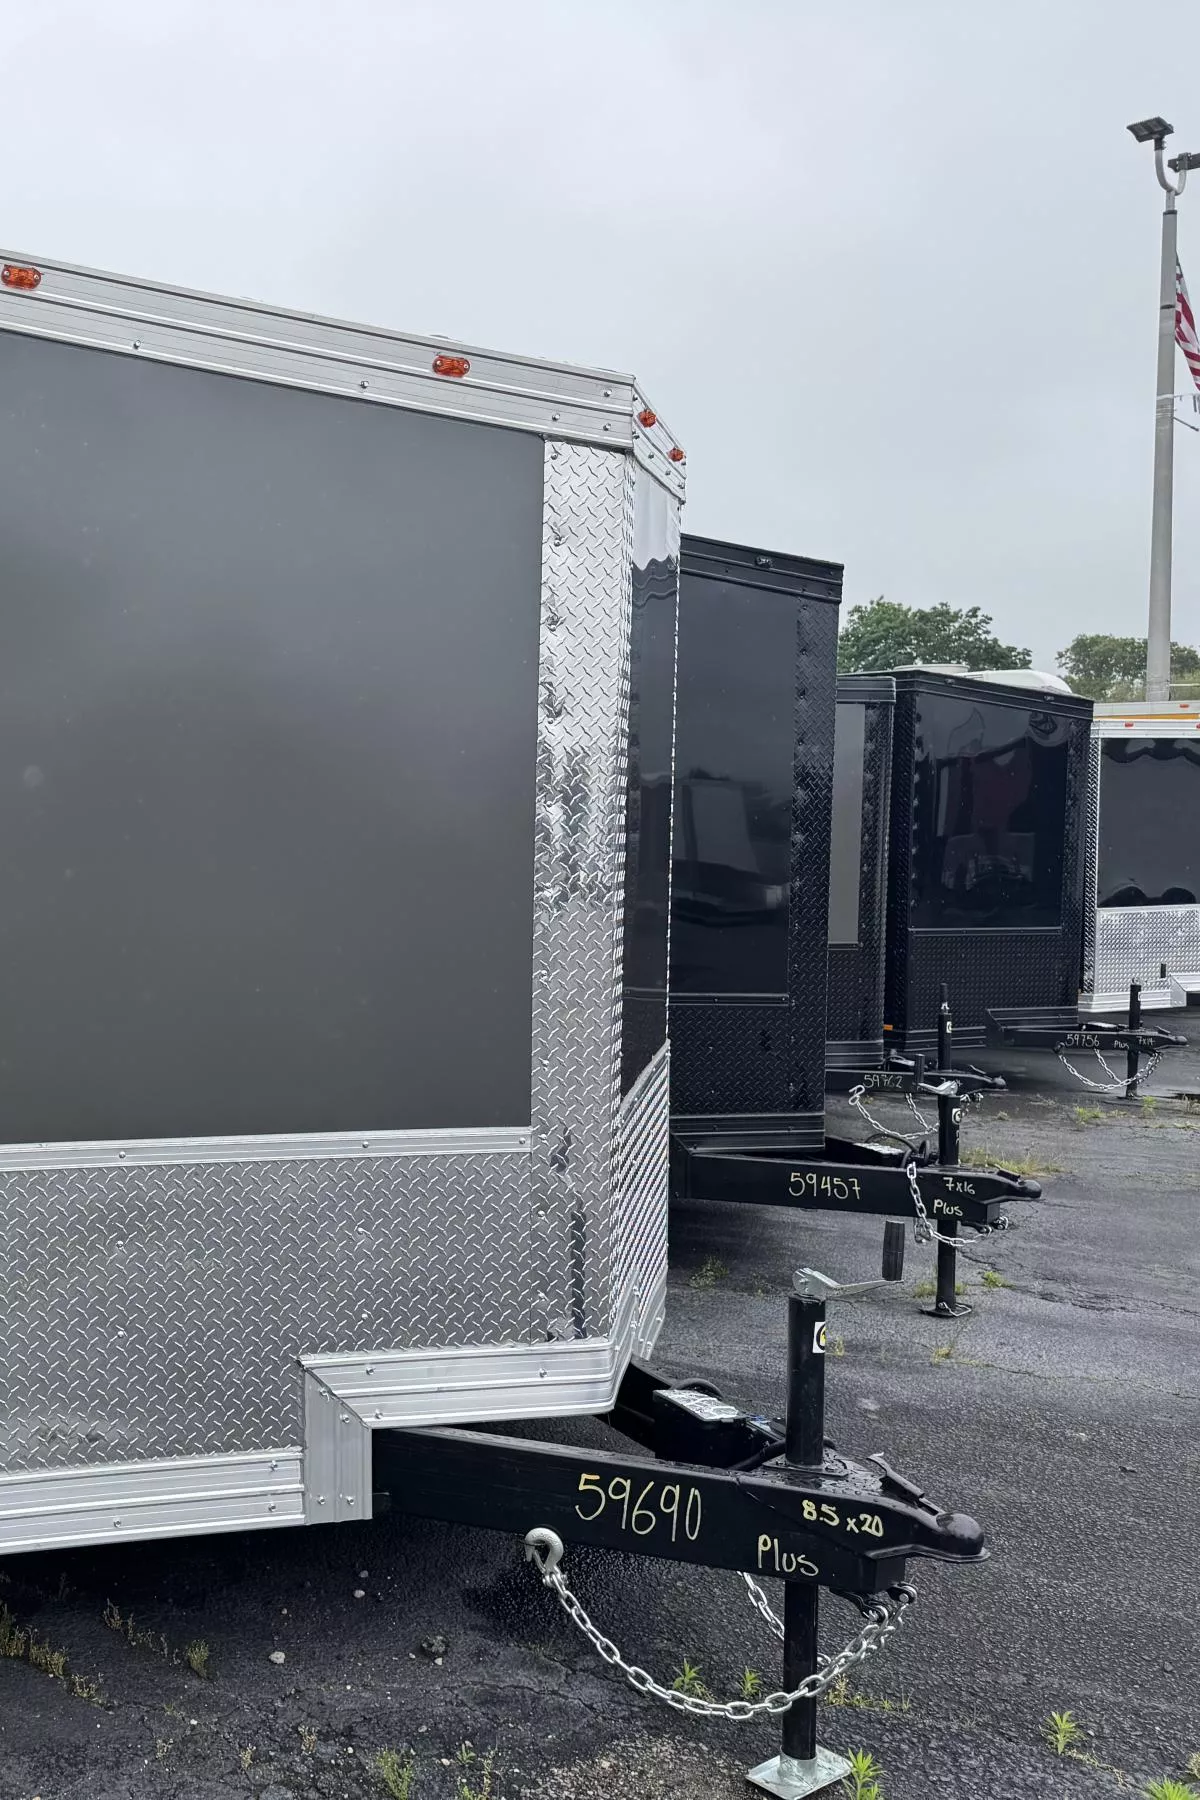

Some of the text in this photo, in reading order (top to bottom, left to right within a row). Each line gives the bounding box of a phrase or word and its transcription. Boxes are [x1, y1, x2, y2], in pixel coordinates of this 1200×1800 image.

[1064, 1034, 1100, 1047] 59756
[788, 1172, 861, 1200] 59457
[933, 1199, 964, 1217] Plus
[575, 1473, 702, 1542] 59690
[758, 1534, 819, 1577] Plus
